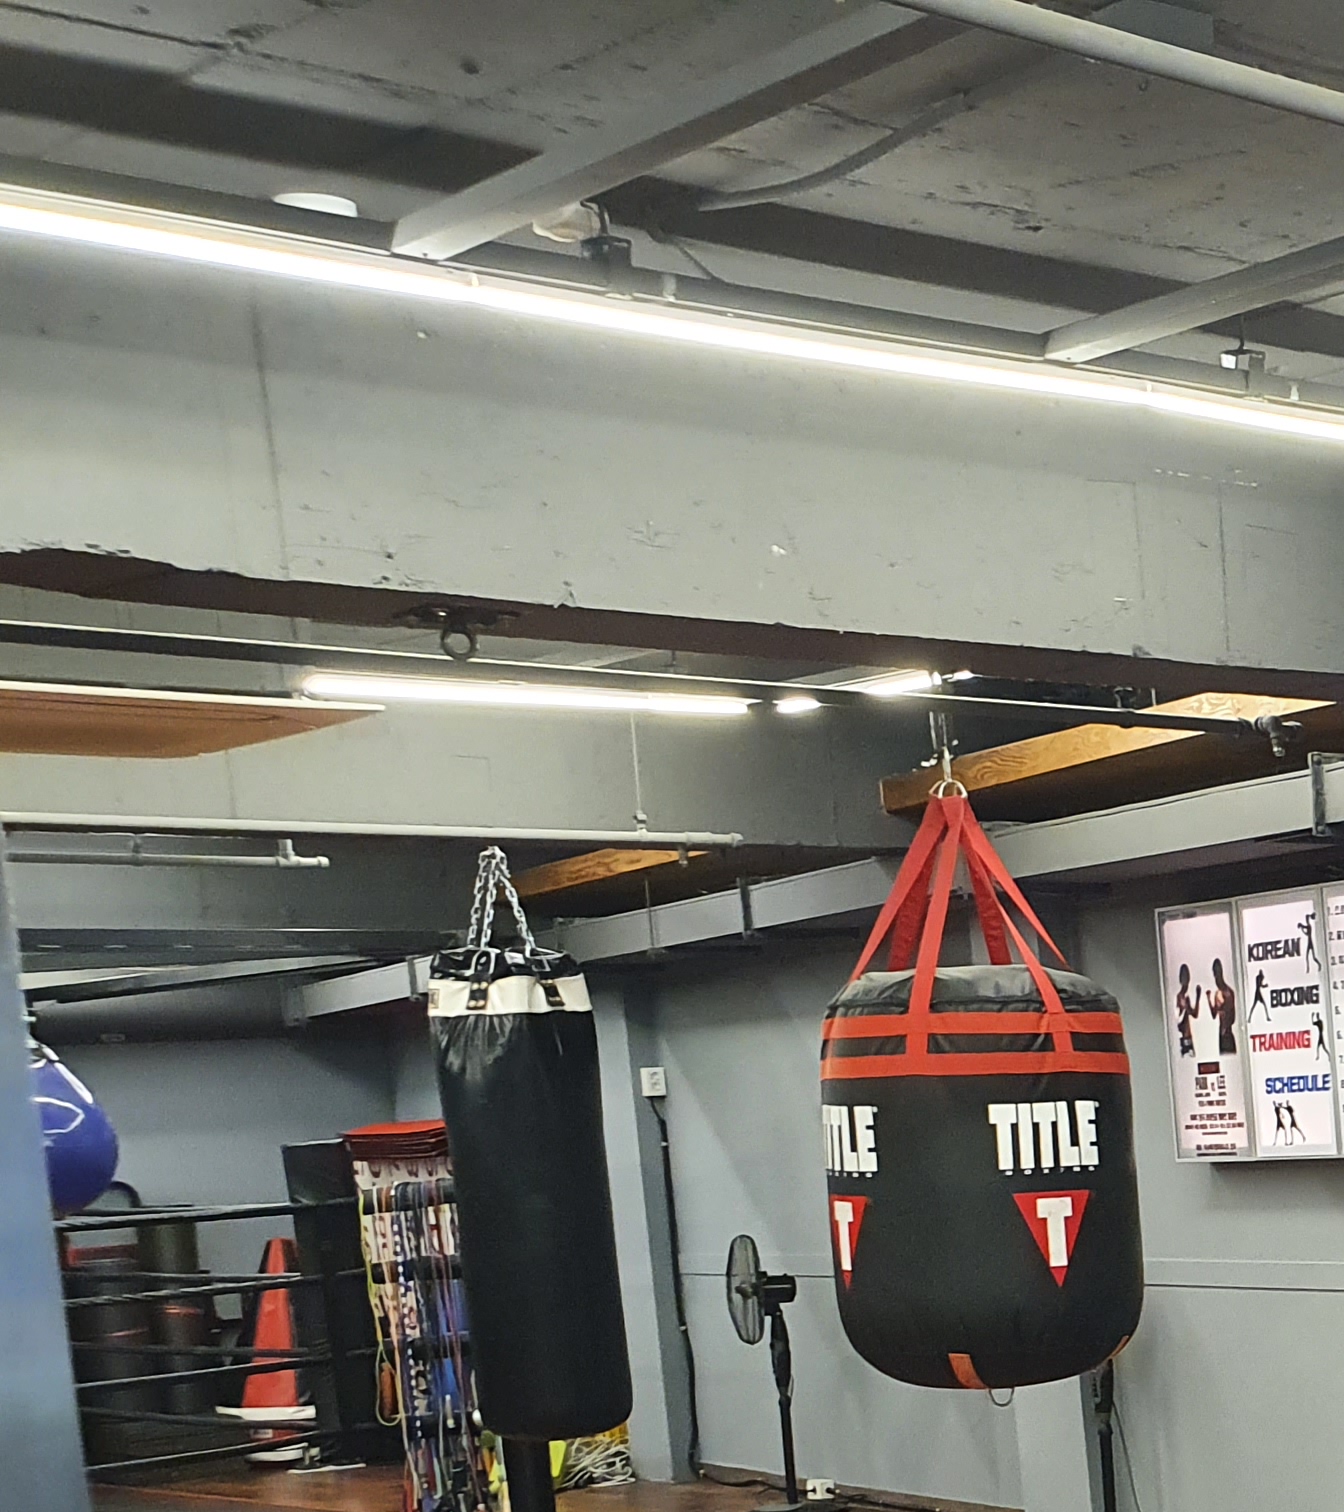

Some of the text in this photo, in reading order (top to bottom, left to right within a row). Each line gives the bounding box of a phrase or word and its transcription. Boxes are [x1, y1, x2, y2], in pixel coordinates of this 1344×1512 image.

[1247, 937, 1301, 962] KOREAN
[1270, 984, 1320, 1008] BOXING
[1250, 1030, 1311, 1052] TRAINING
[1265, 1073, 1331, 1094] SCHEDULE
[988, 1100, 1099, 1171] TITLE
[833, 1200, 854, 1271] T
[1036, 1196, 1072, 1267] T
